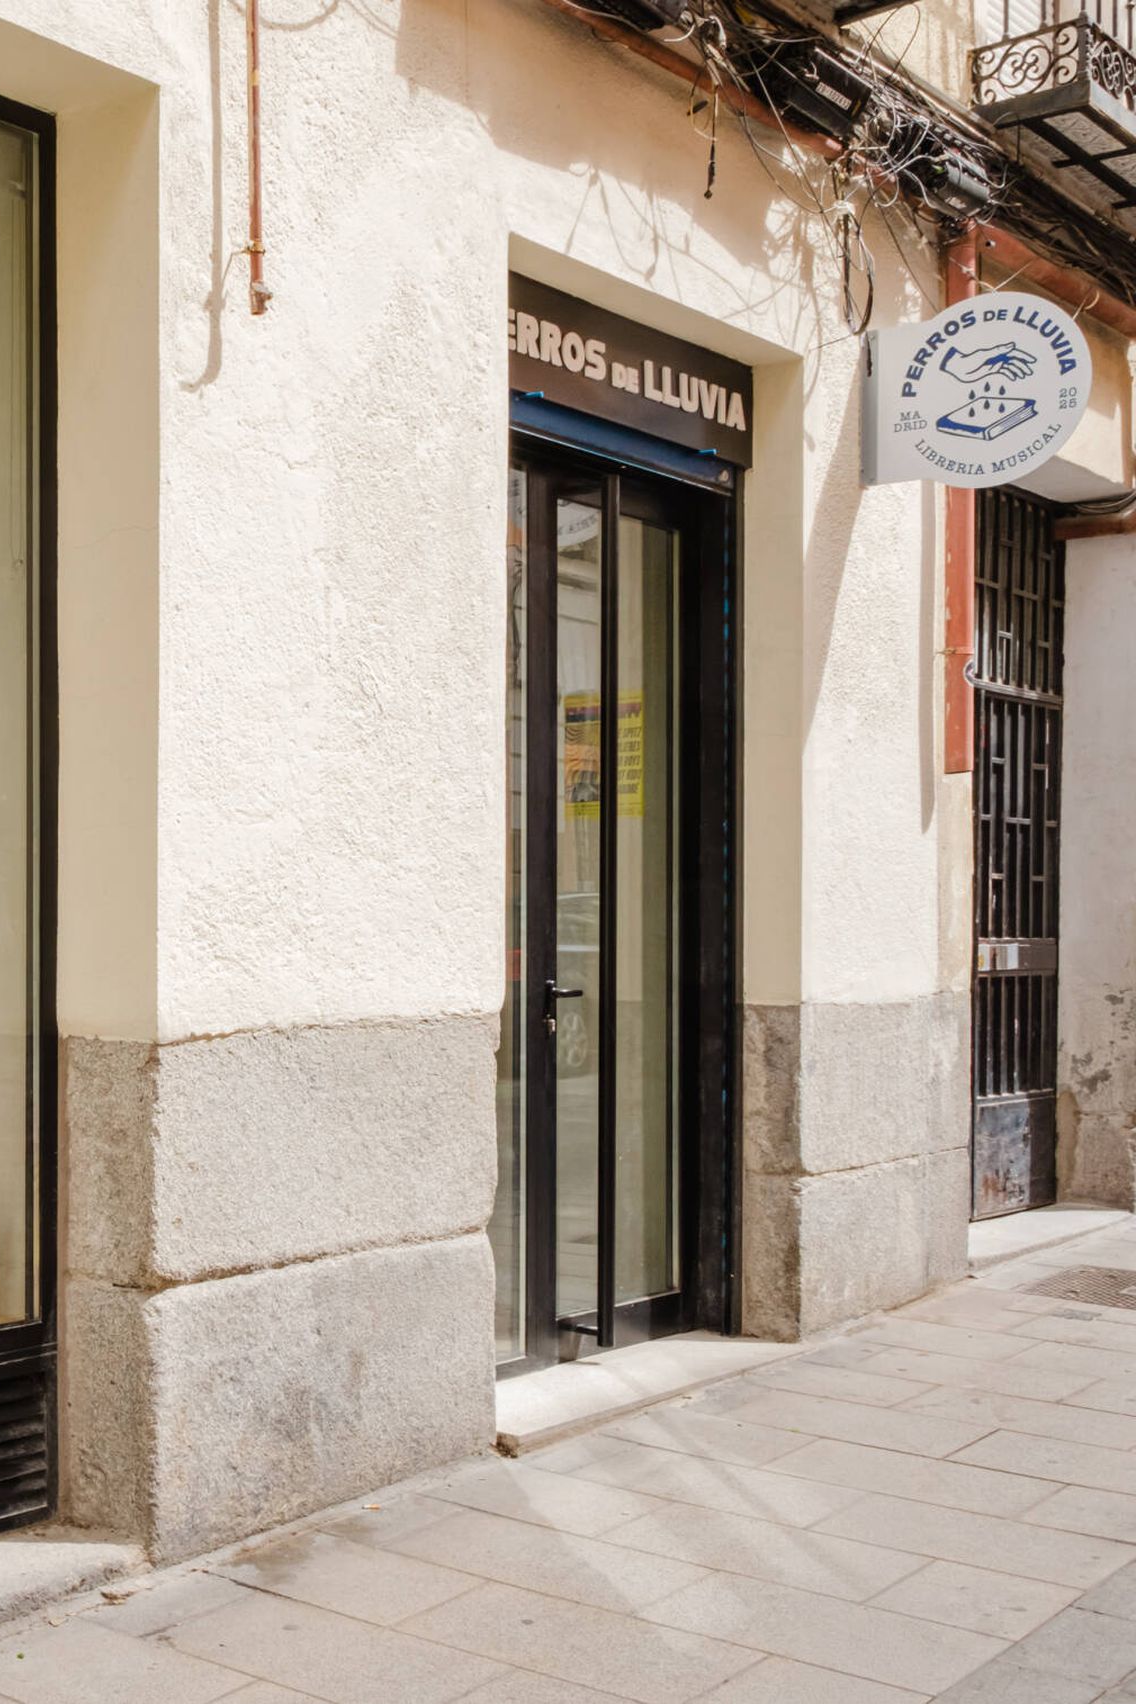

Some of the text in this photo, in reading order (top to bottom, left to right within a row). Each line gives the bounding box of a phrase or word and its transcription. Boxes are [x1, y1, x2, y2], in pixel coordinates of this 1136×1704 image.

[901, 306, 1077, 398] PERROS DE LLUVIA
[611, 362, 639, 394] DE
[644, 359, 747, 432] LLUVIA
[1059, 387, 1077, 398] 20
[893, 420, 928, 433] DRID
[899, 411, 921, 422] MA
[914, 422, 1062, 475] LIBRERIA MUSICAL
